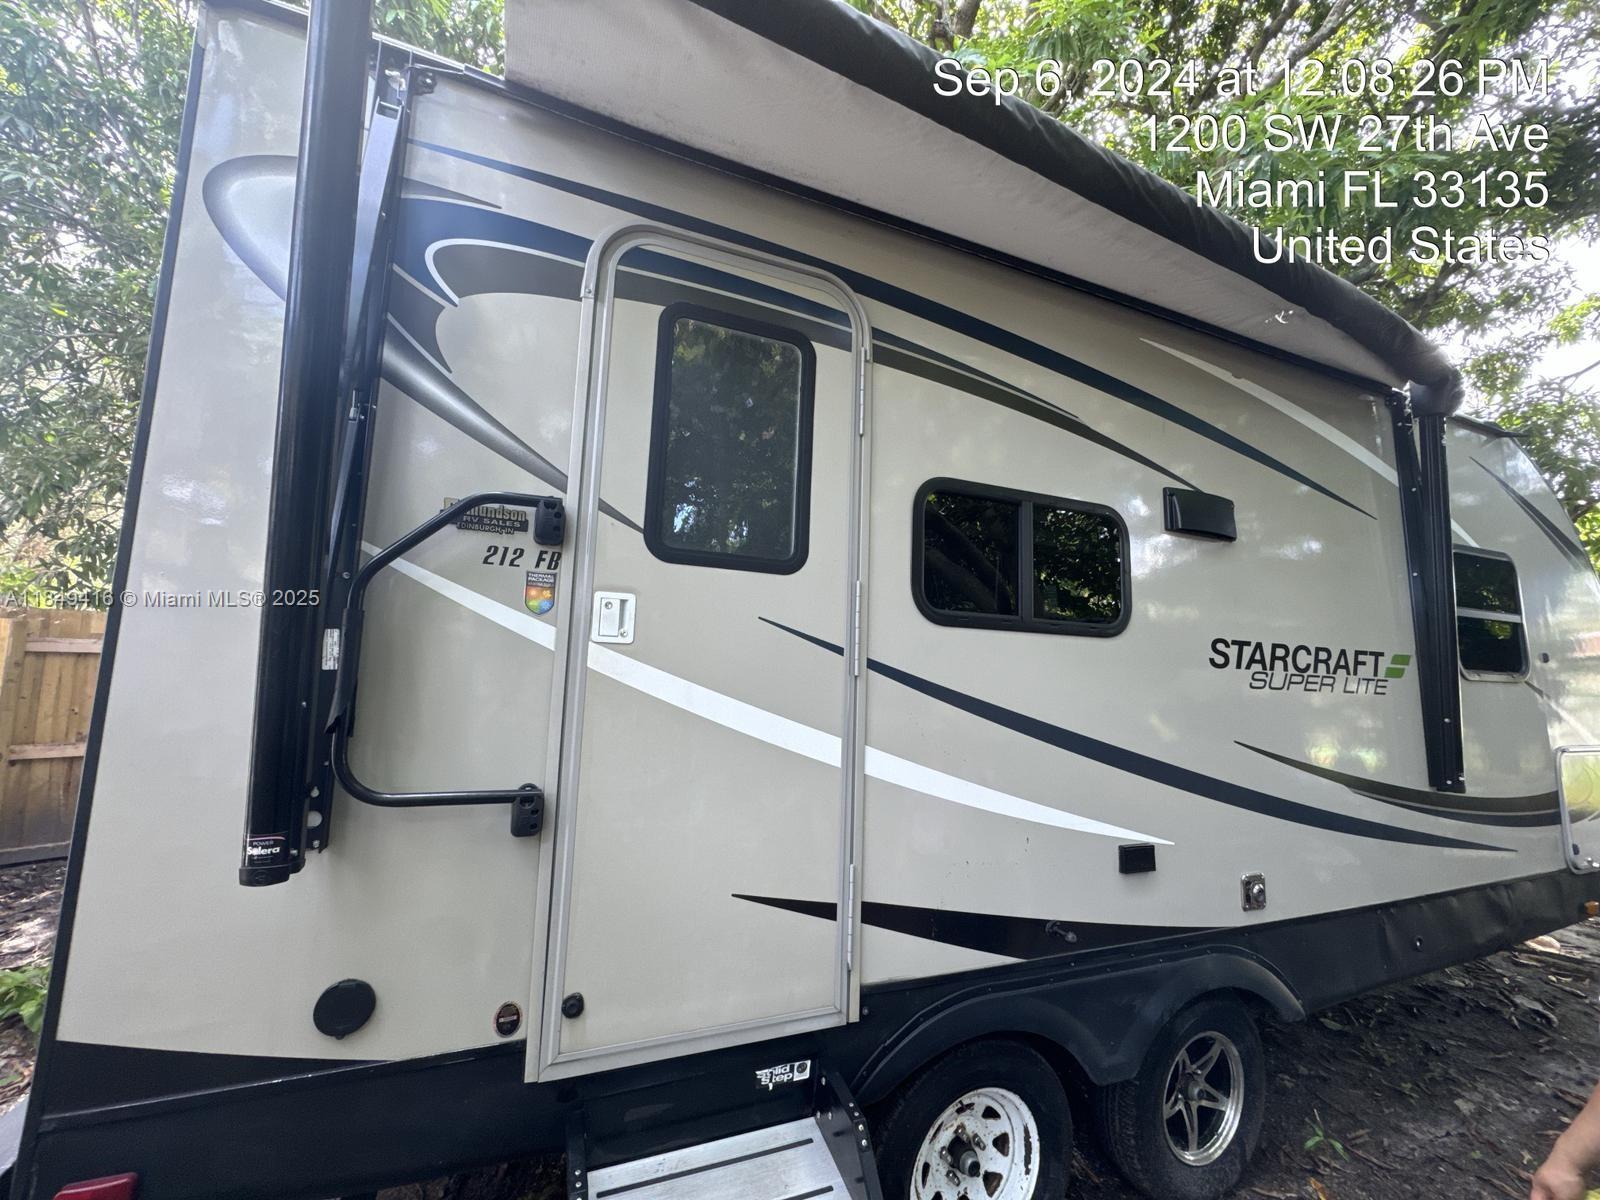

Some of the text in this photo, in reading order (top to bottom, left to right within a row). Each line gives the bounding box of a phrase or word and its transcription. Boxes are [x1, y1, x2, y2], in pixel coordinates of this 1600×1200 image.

[483, 518, 521, 528] SALES
[482, 545, 562, 570] 212 FB
[1208, 637, 1385, 678] STARCRAFT
[1249, 670, 1389, 696] SUPER LITE
